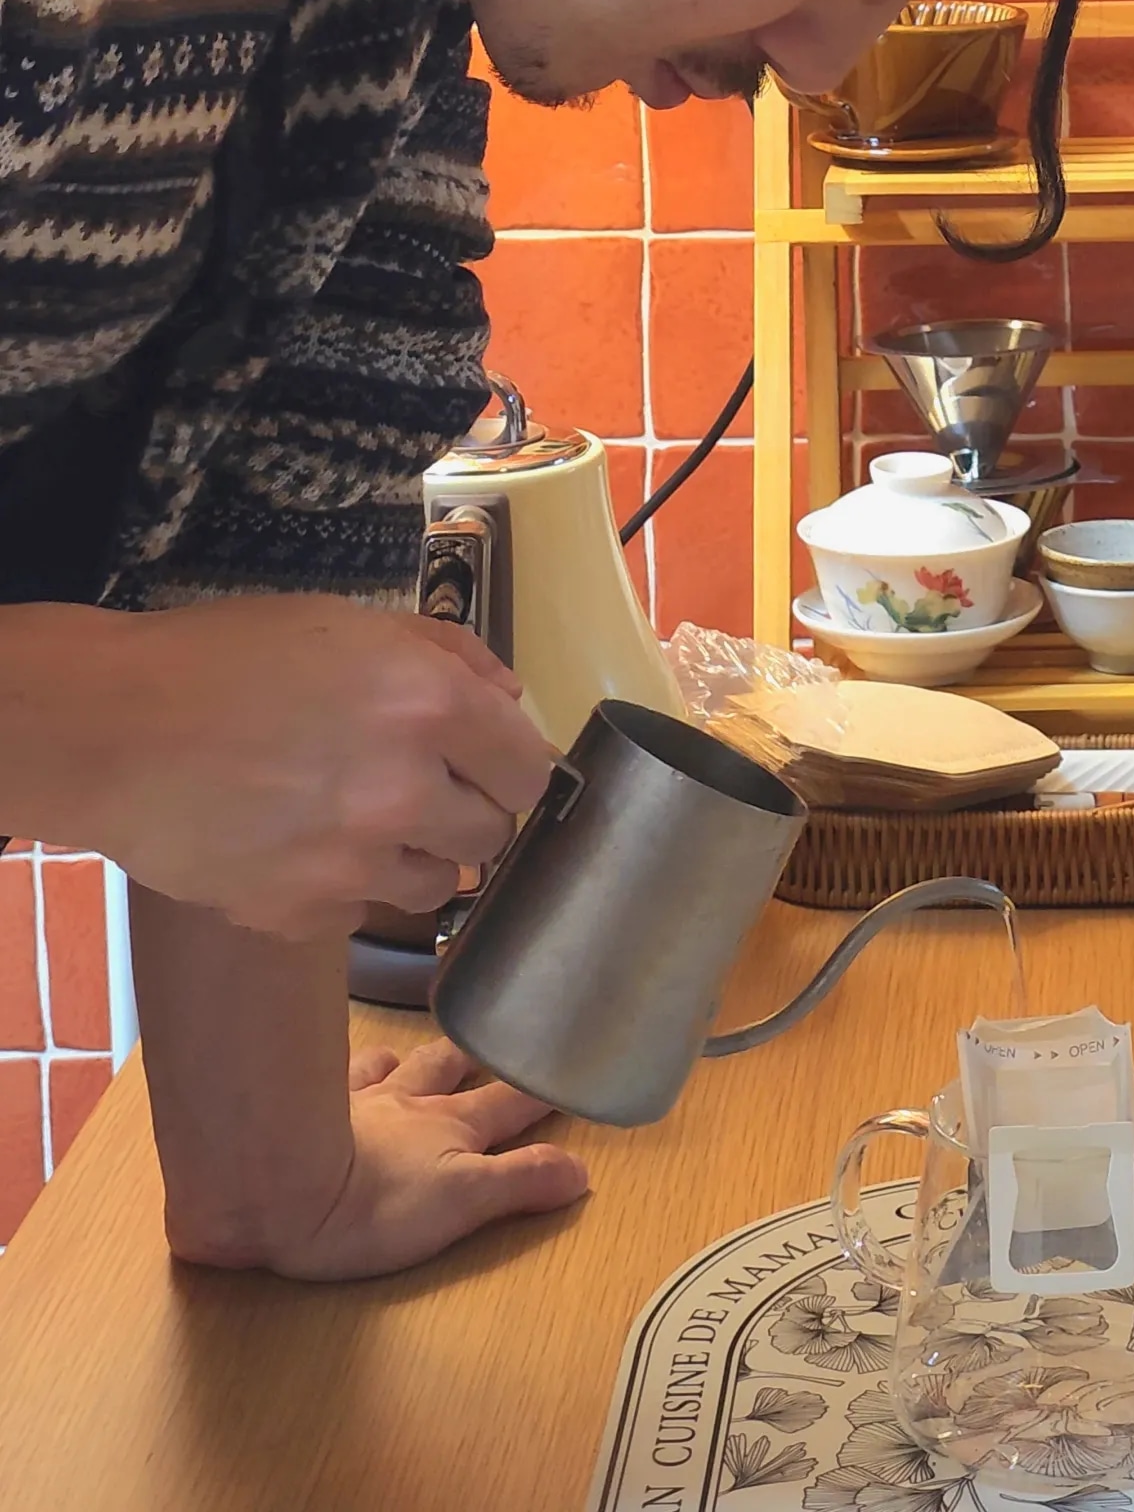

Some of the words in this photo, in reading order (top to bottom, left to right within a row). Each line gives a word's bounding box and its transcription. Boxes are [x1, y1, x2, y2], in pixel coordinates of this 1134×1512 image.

[1068, 1039, 1105, 1059] OPEN
[706, 1224, 838, 1304] MAMA
[677, 1307, 730, 1345] DE
[651, 1350, 710, 1468] CUISINE
